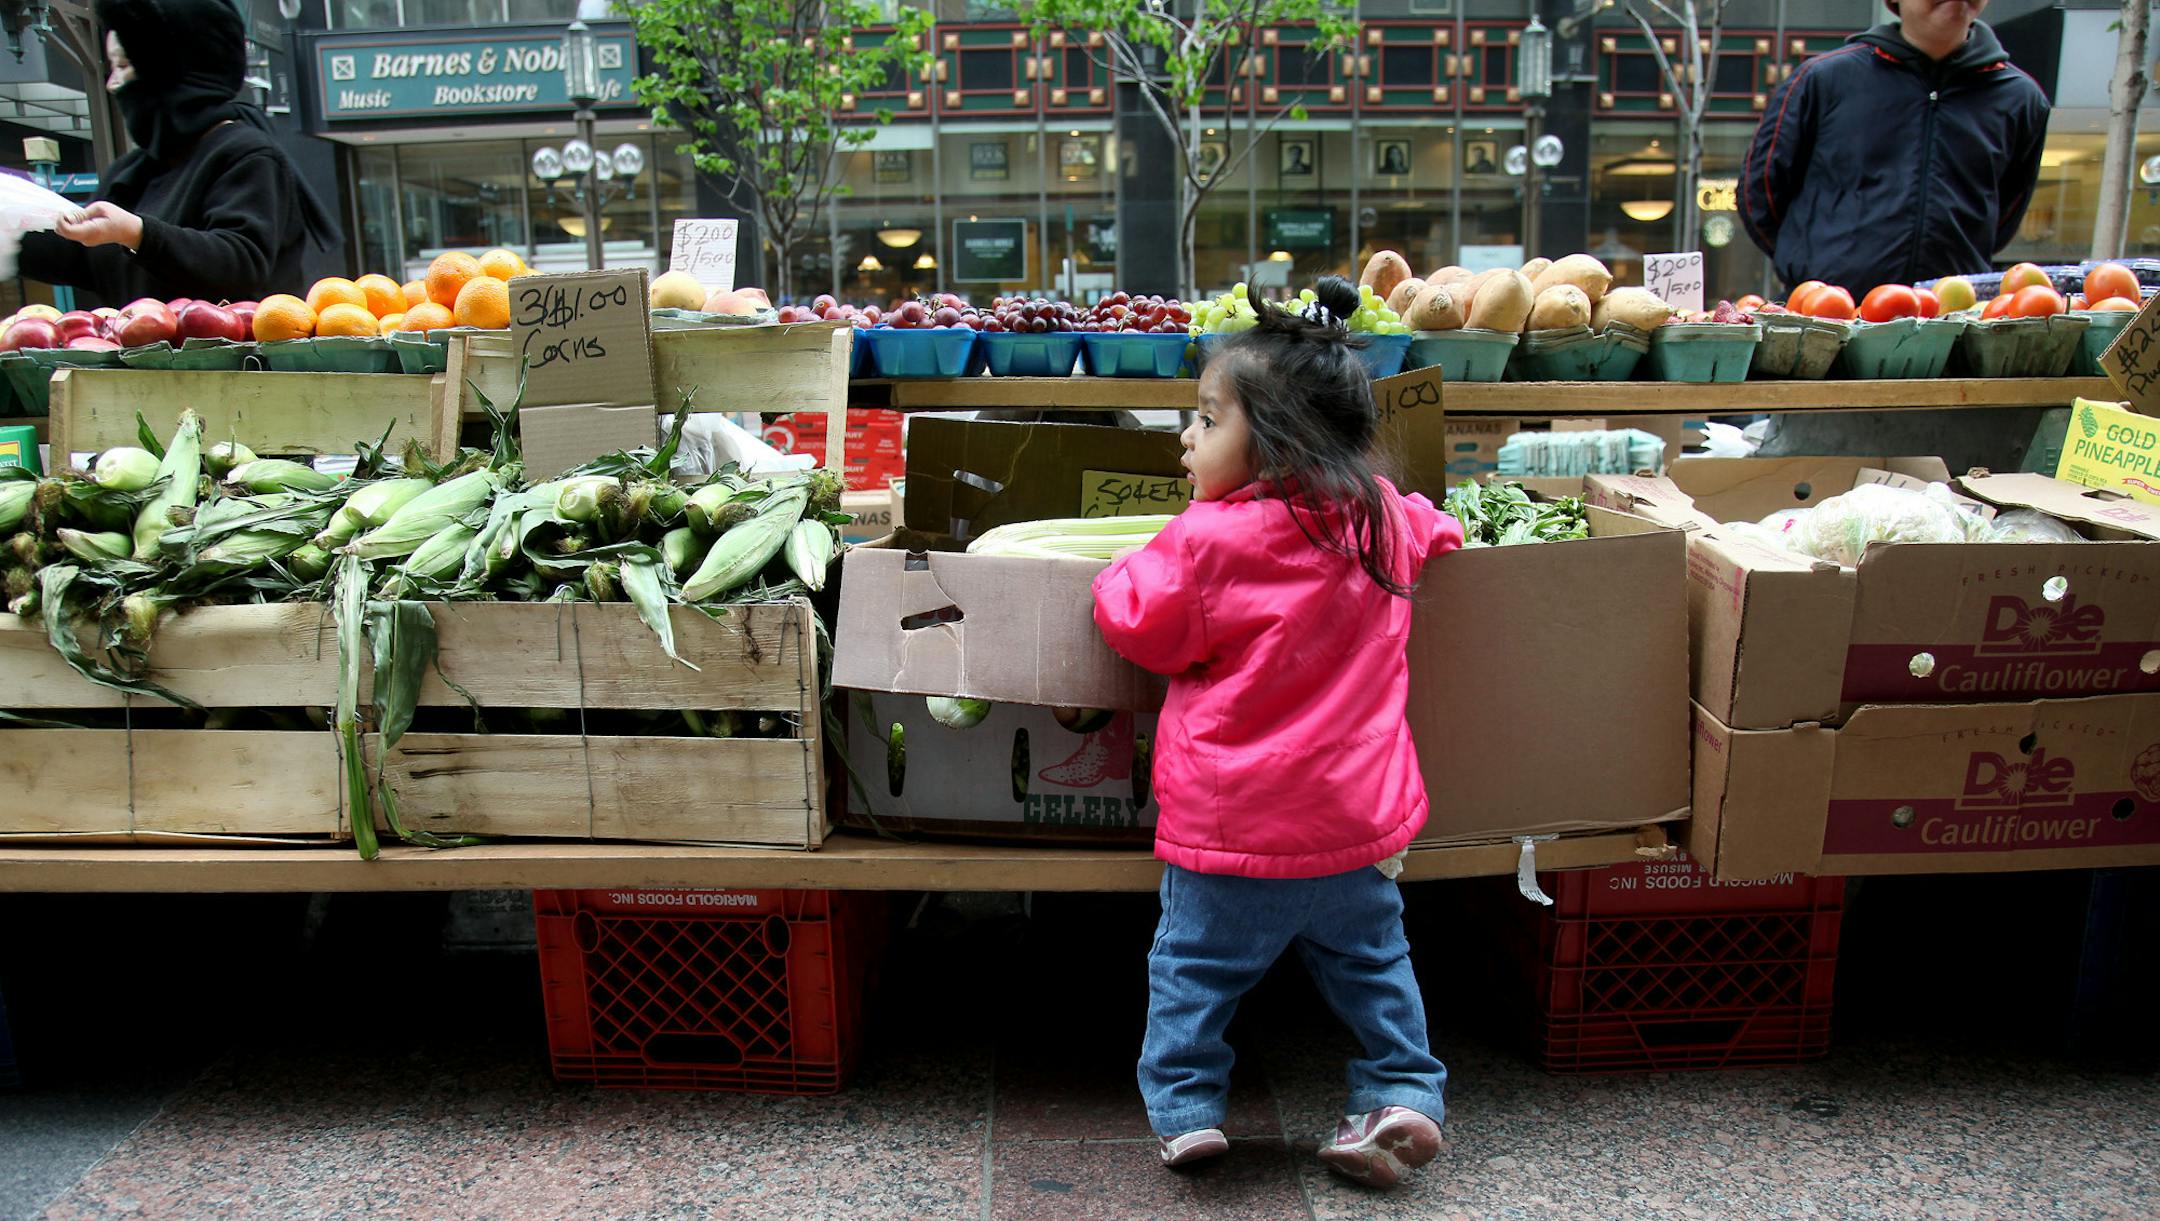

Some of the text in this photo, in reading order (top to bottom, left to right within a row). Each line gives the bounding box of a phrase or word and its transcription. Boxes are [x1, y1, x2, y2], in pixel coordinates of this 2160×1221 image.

[371, 46, 567, 79] Barnes & Nobl
[338, 89, 391, 110] Music
[434, 82, 538, 106] Bookstore
[1378, 380, 1440, 425] 1.00
[2106, 424, 2157, 450] GOLD
[2074, 439, 2160, 479] PINEAPPLE
[1963, 564, 2036, 587] FRESH
[1981, 593, 2105, 648] Dole
[1938, 661, 2128, 693] Cauliflower
[1963, 747, 2075, 799] Dole
[1023, 794, 1143, 828] CELERY
[1920, 815, 2102, 846] Cauliflower
[1643, 863, 1693, 875] MISUSE
[1645, 875, 1703, 890] FOODS
[608, 892, 758, 907] MARIGOLD FOODS INC.
